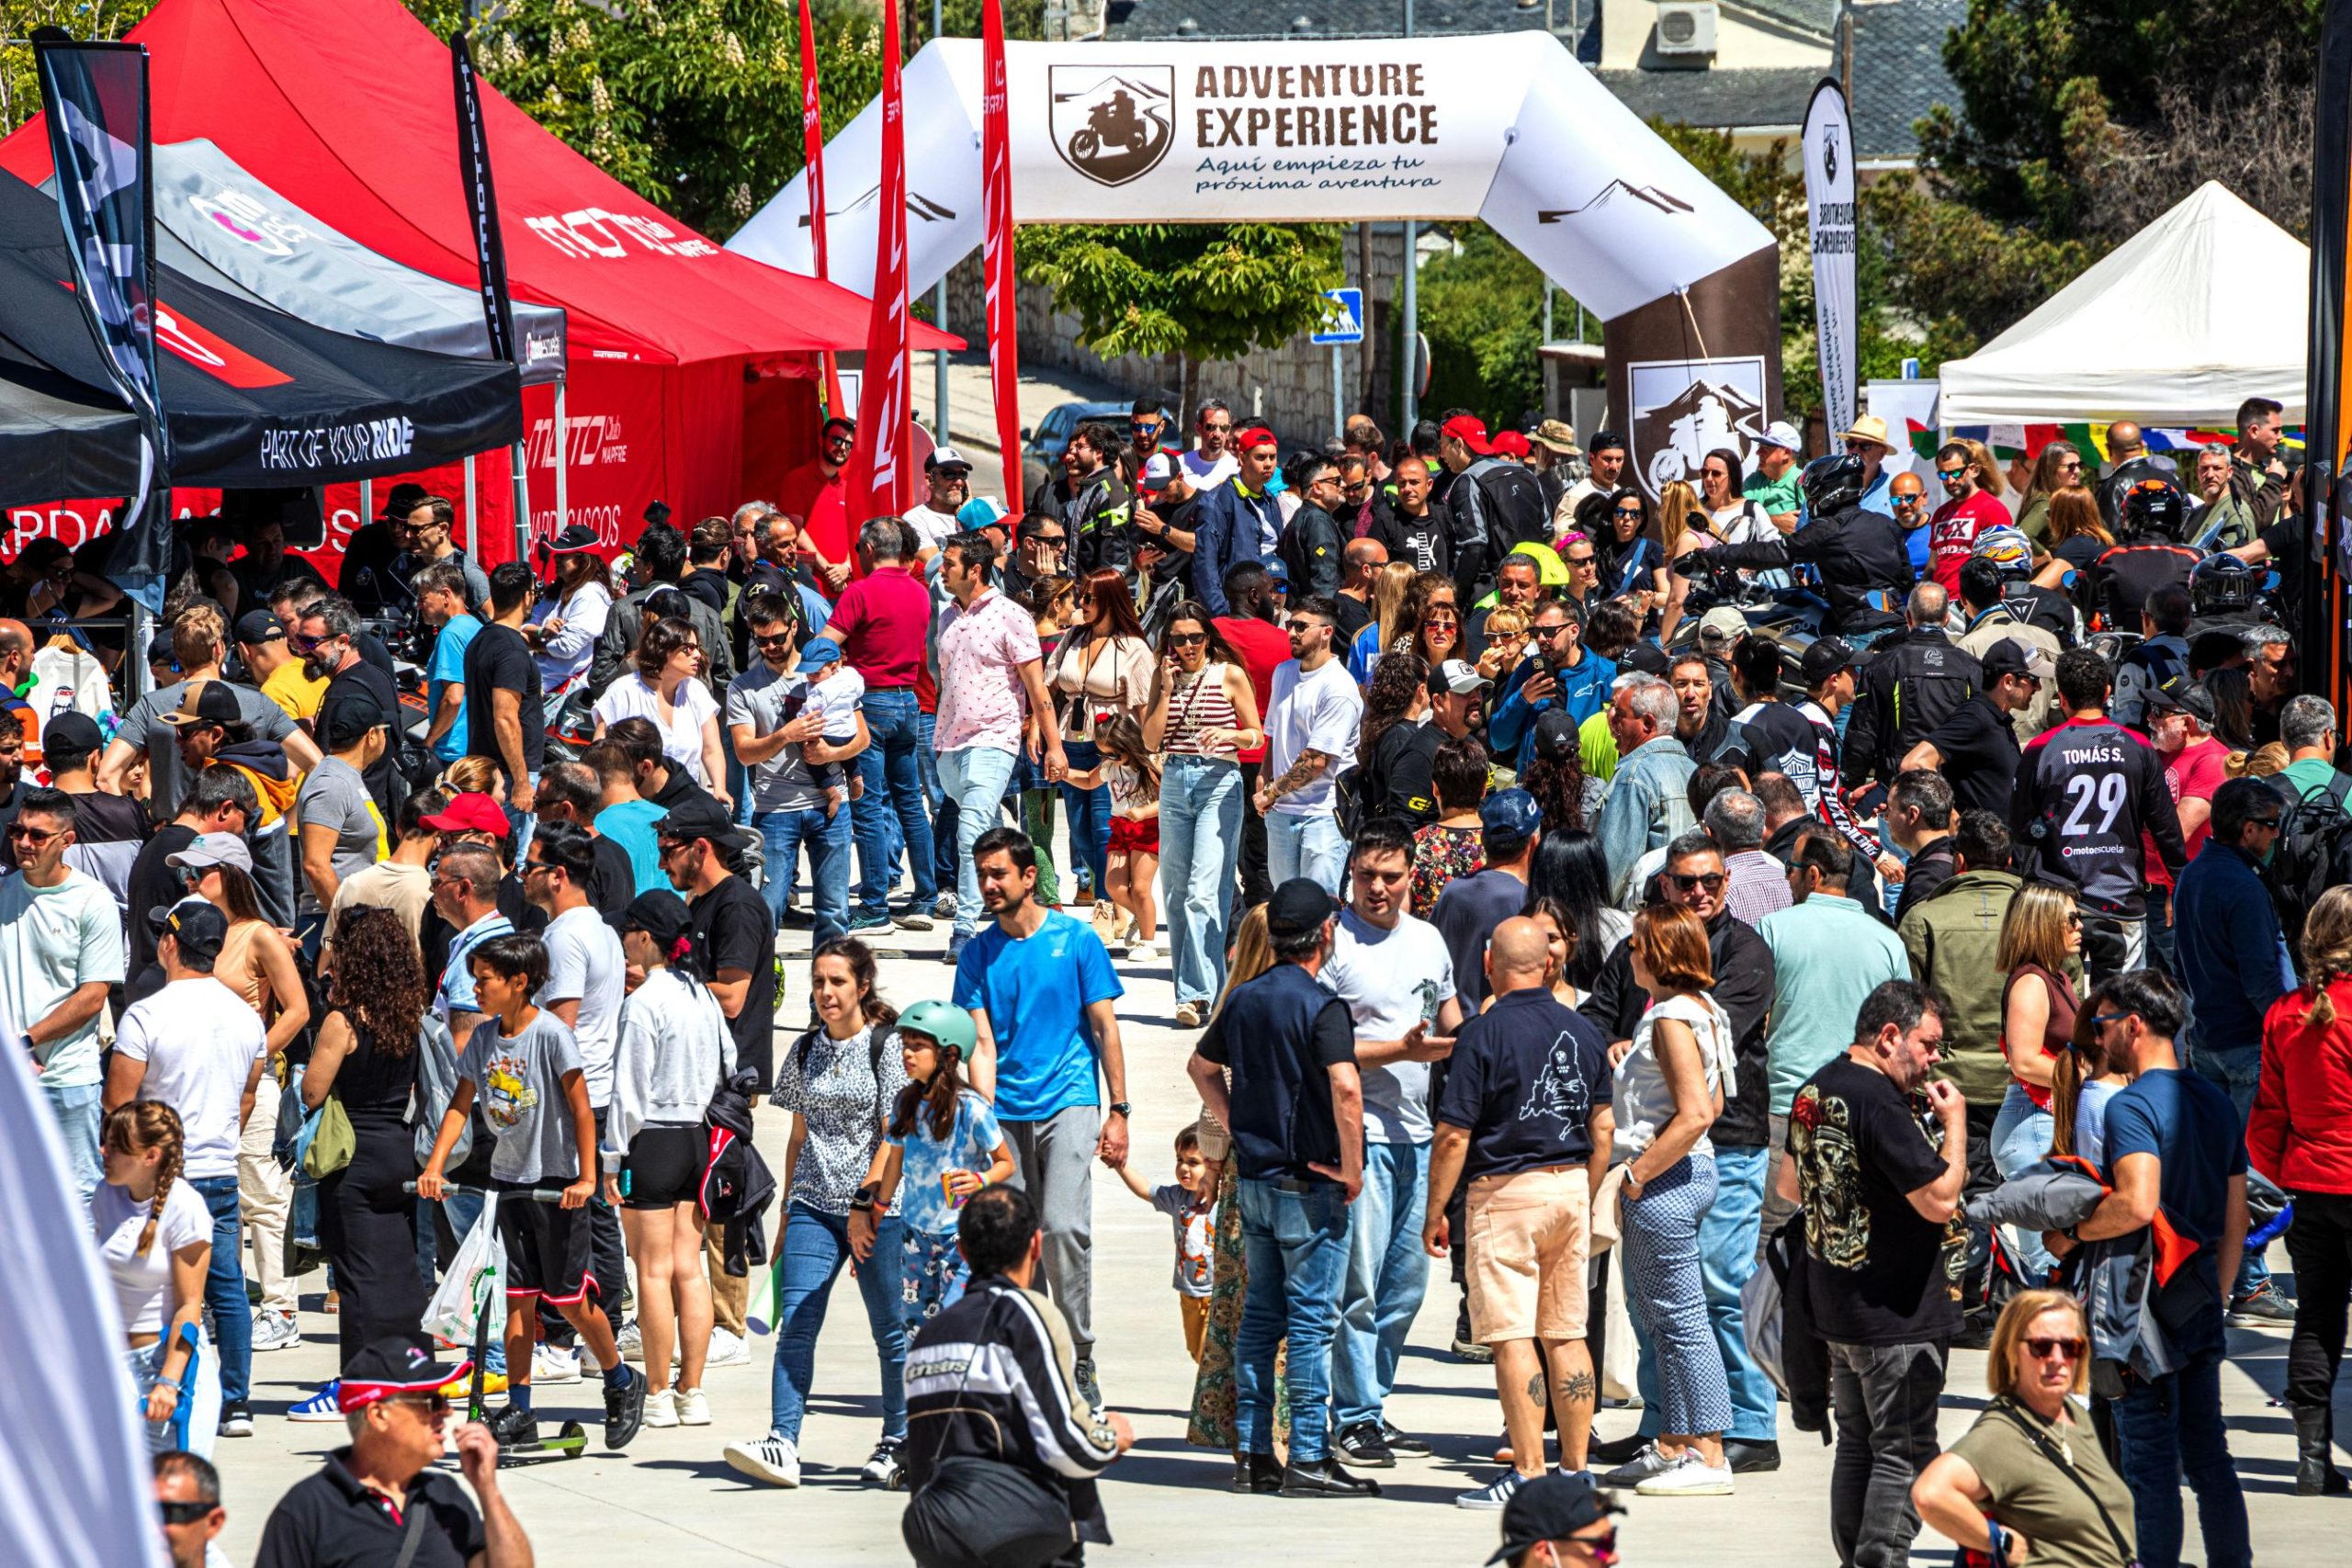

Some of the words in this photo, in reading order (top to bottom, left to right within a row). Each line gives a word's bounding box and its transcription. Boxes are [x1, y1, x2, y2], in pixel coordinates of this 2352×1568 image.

[1195, 63, 1424, 99] ADVENTURE
[1196, 102, 1439, 148] EXPERIENCE
[1195, 156, 1267, 175] Aquí
[1272, 154, 1386, 175] empieza
[1391, 153, 1426, 170] tu
[1195, 175, 1313, 194] próxima
[1317, 175, 1442, 189] aventura
[605, 413, 622, 441] Club
[261, 428, 300, 469] PART
[300, 428, 326, 468] OF
[328, 423, 370, 466] YOUR
[369, 415, 415, 460] RIDE
[601, 445, 628, 463] MAPFRE
[1416, 532, 1431, 570] PUMA
[2062, 745, 2109, 765] TOMÁS
[2111, 747, 2125, 763] S.
[2061, 773, 2128, 837] 29
[2073, 844, 2125, 856] motoescuela
